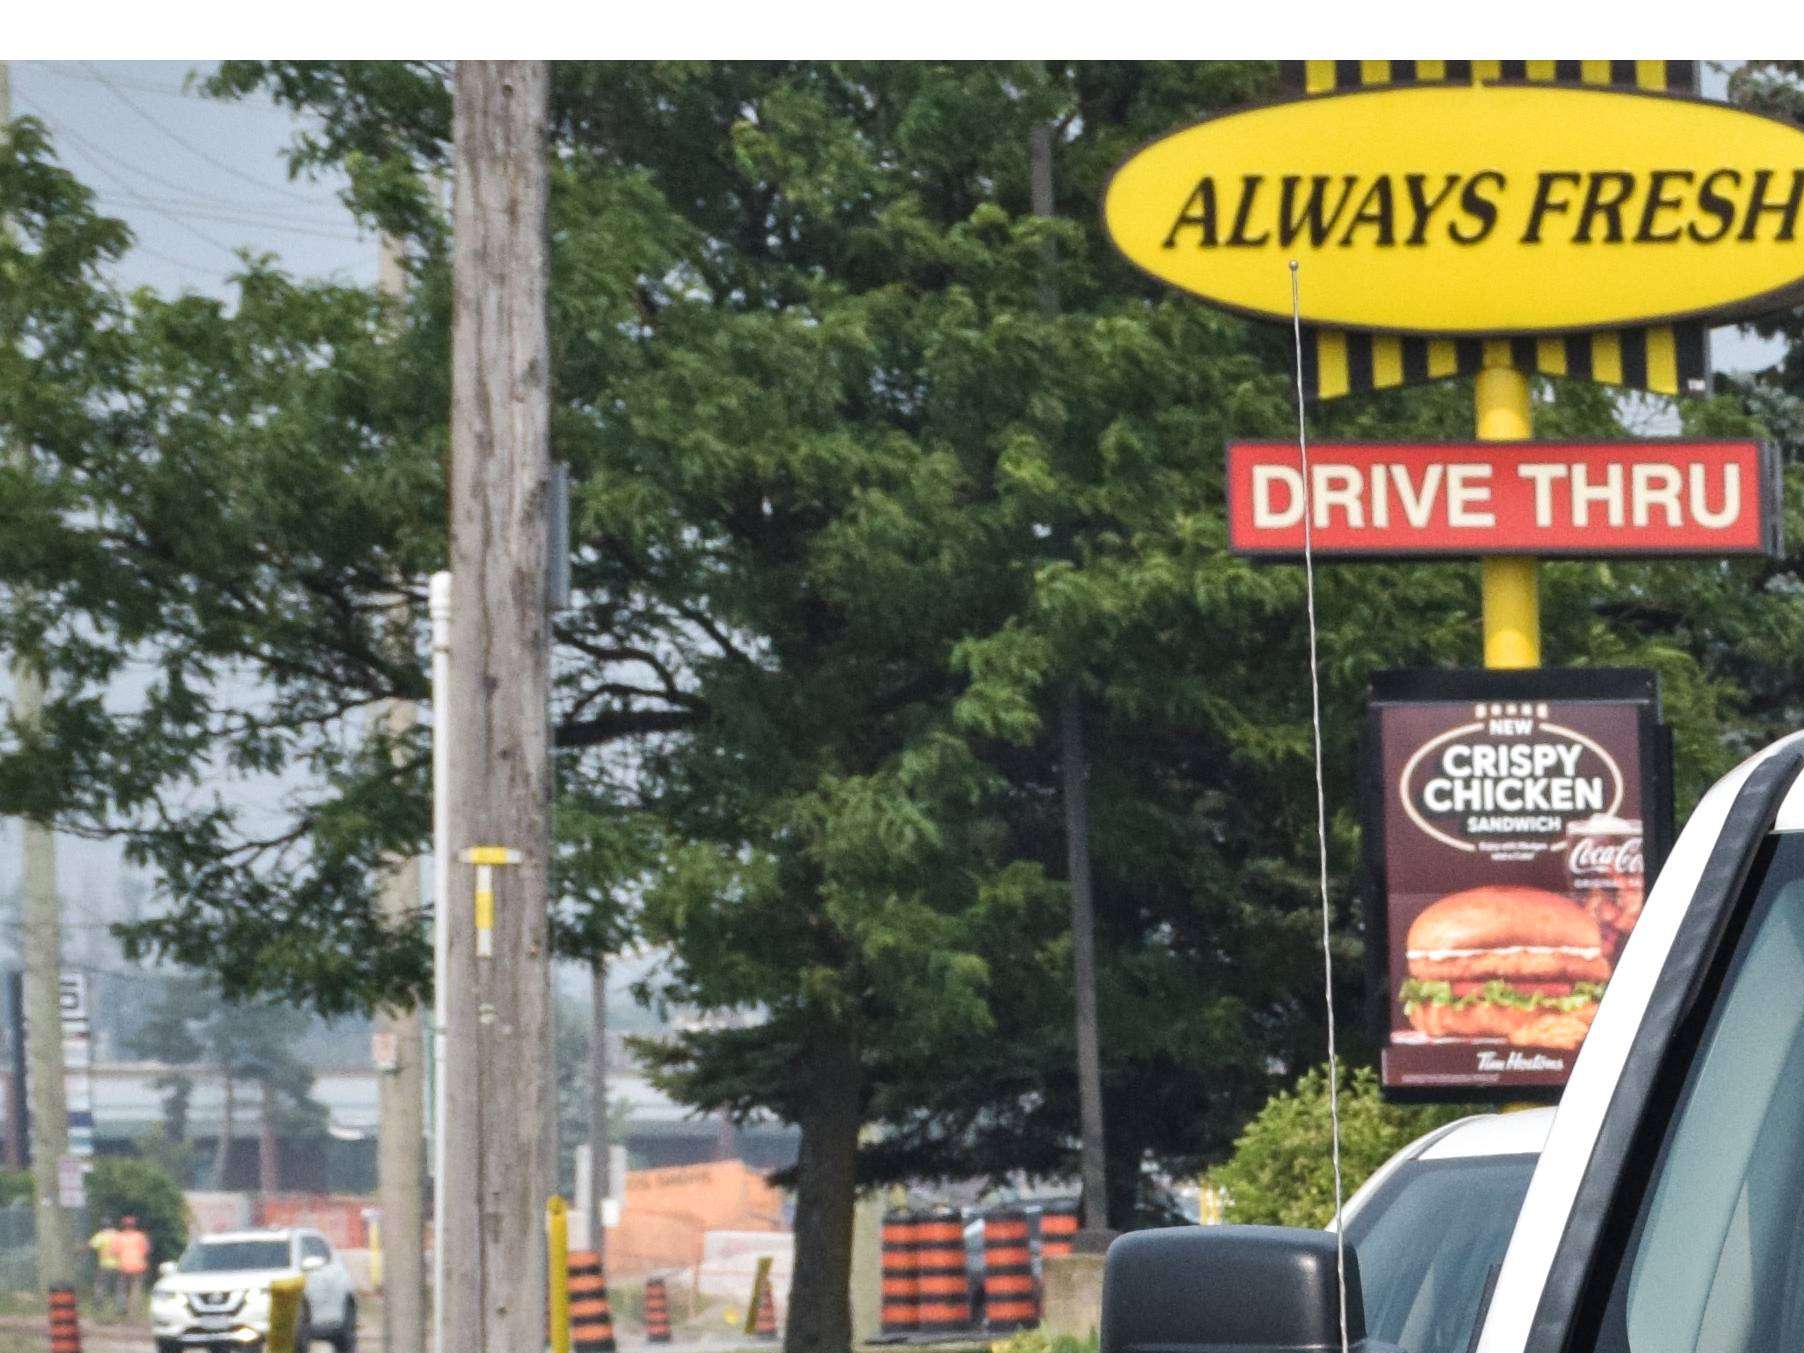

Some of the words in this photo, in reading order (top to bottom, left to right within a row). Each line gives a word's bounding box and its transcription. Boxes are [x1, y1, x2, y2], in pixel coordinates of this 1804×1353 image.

[1162, 172, 1508, 249] ALWAYS
[1251, 463, 1496, 530] DRIVE
[1518, 461, 1740, 527] THRU
[1488, 719, 1534, 736] NEW
[1442, 744, 1584, 778] CRISPY
[1423, 777, 1604, 812] CHICKEN
[1467, 815, 1563, 834] SANDWICH
